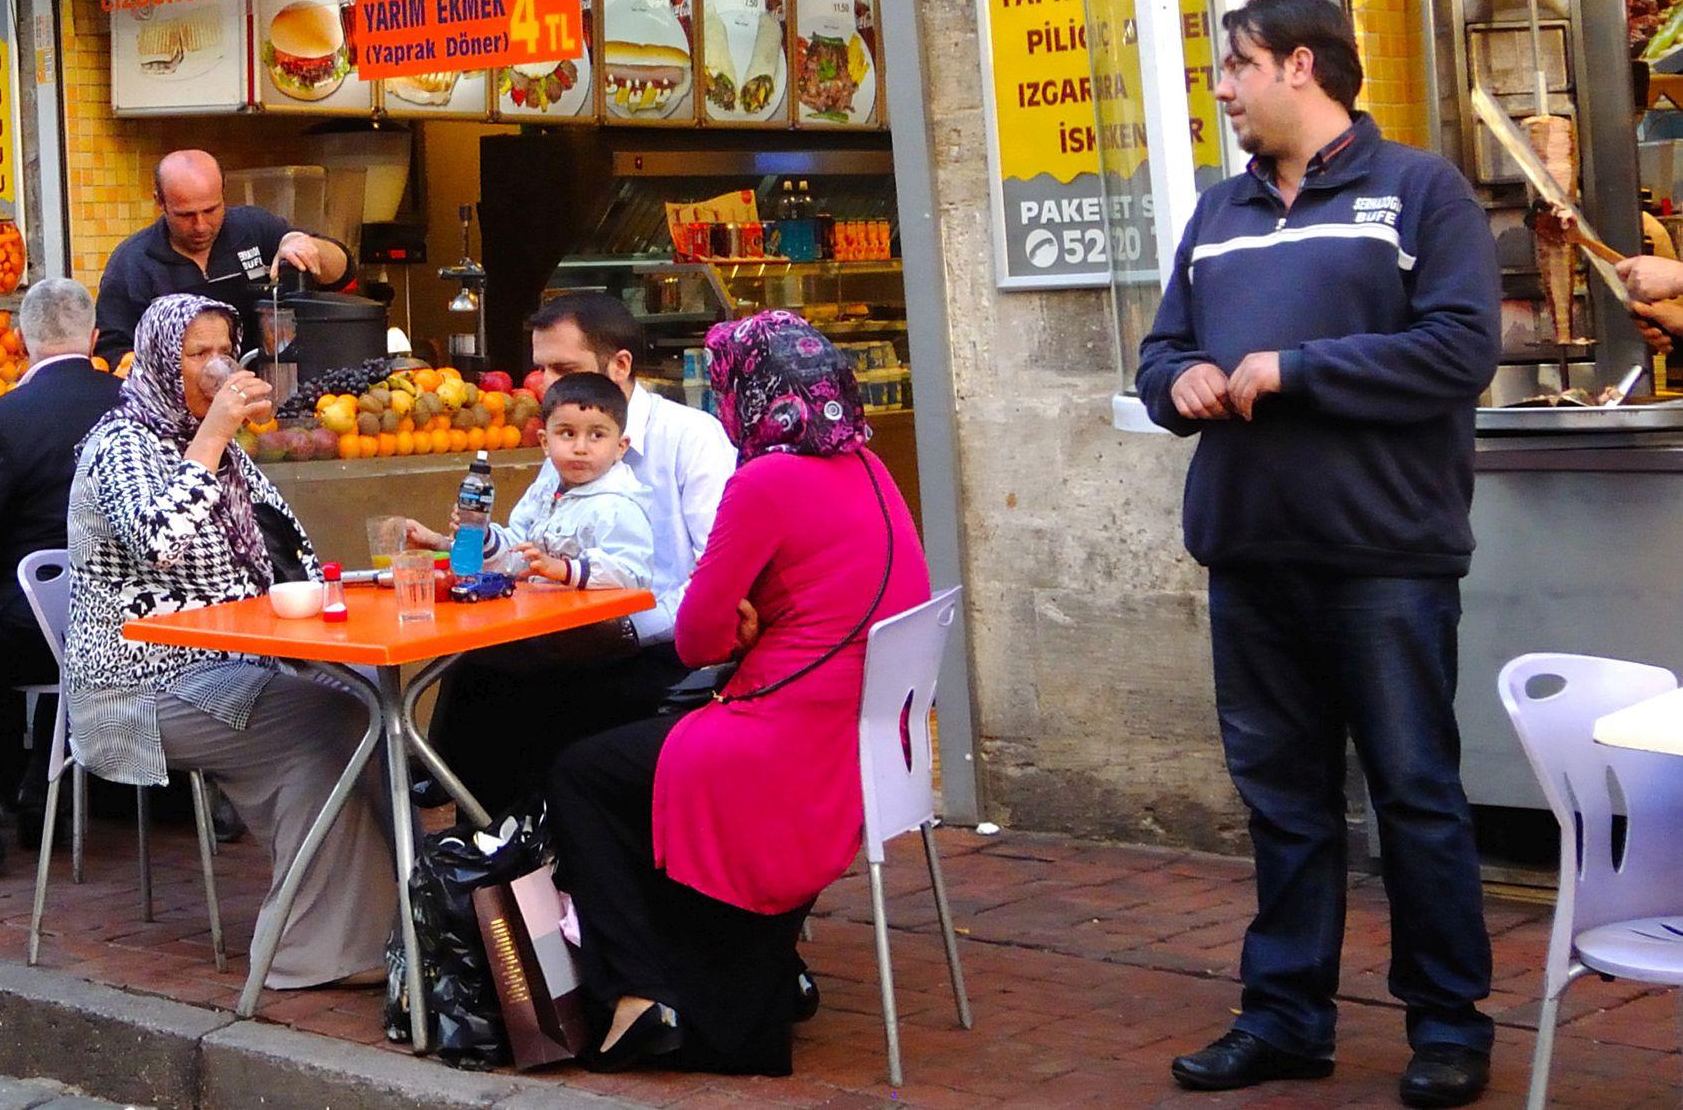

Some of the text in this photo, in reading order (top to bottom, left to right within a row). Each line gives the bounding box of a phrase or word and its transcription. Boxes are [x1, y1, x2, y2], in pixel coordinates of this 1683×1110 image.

[365, 30, 510, 67] (Yaprak Döner)
[545, 13, 575, 53] TL
